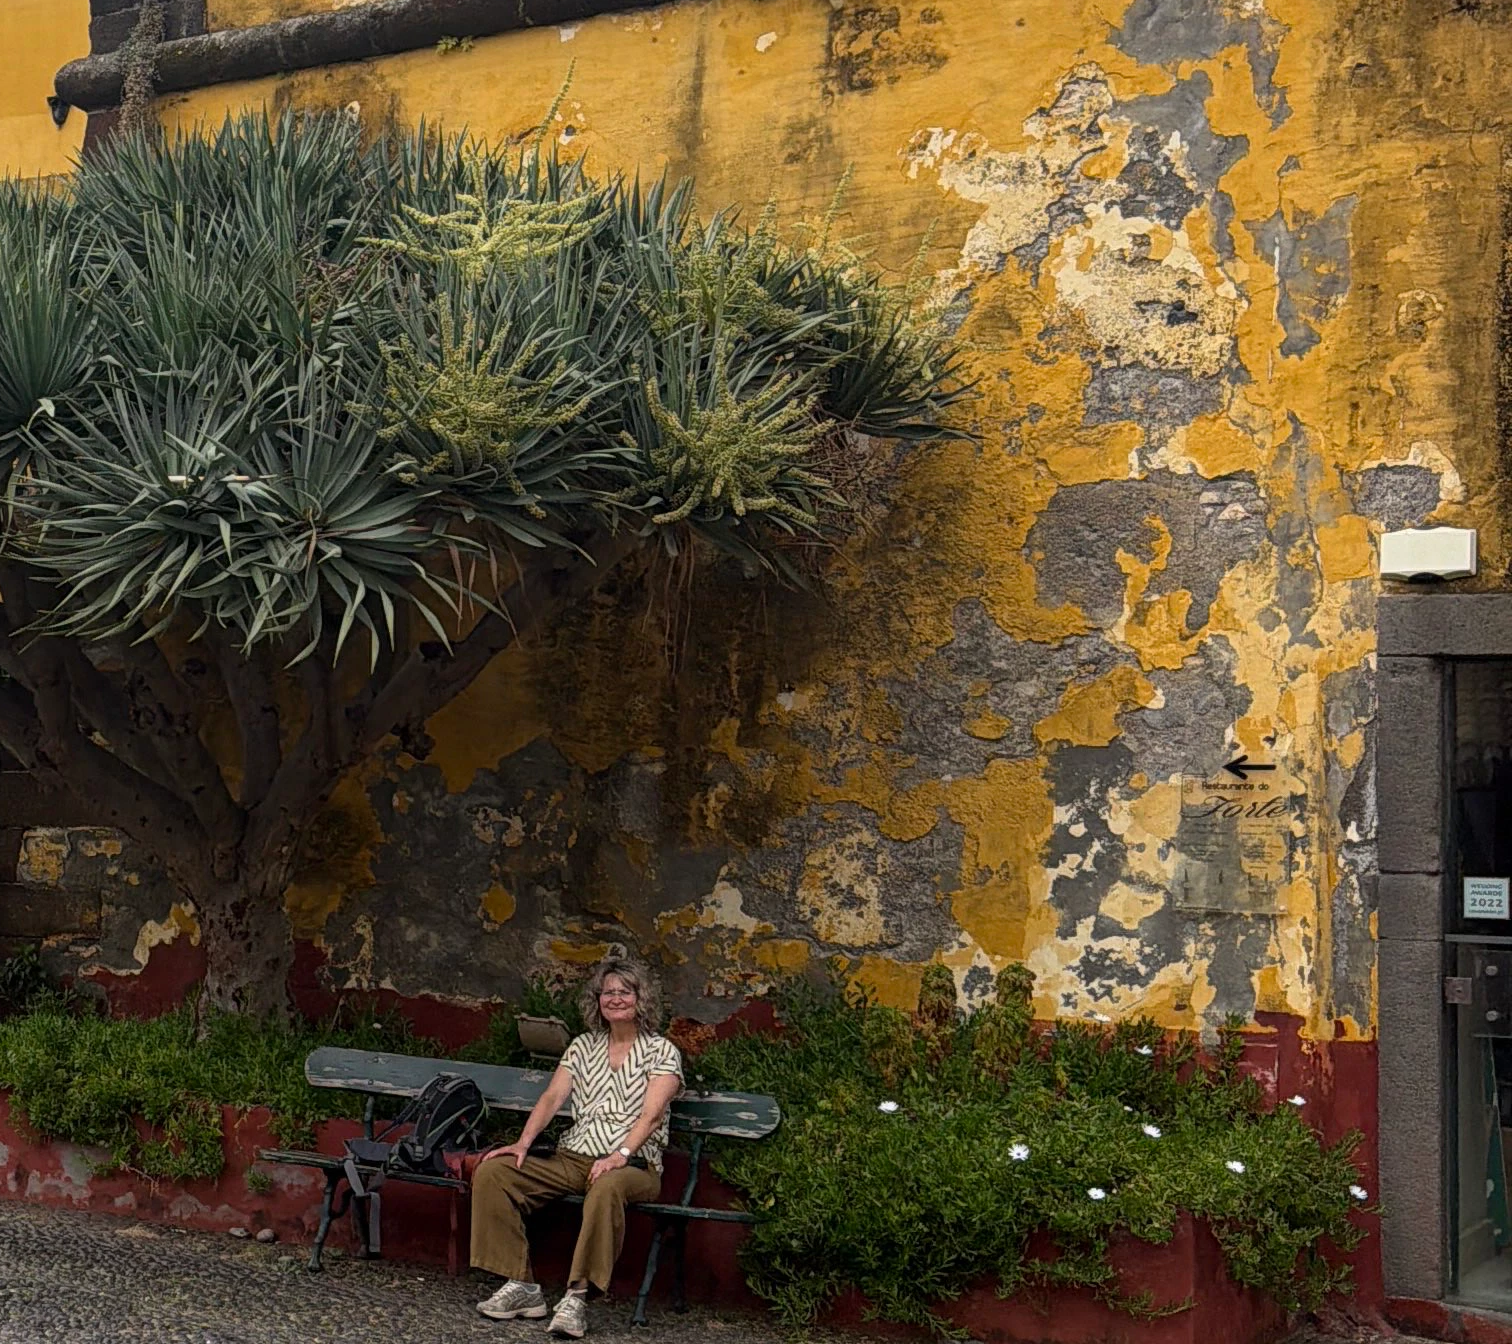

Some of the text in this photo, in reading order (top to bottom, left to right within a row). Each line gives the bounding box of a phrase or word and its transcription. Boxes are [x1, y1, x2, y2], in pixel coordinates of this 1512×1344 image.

[1202, 781, 1269, 791] Restaurante do
[1470, 898, 1503, 907] 2022
